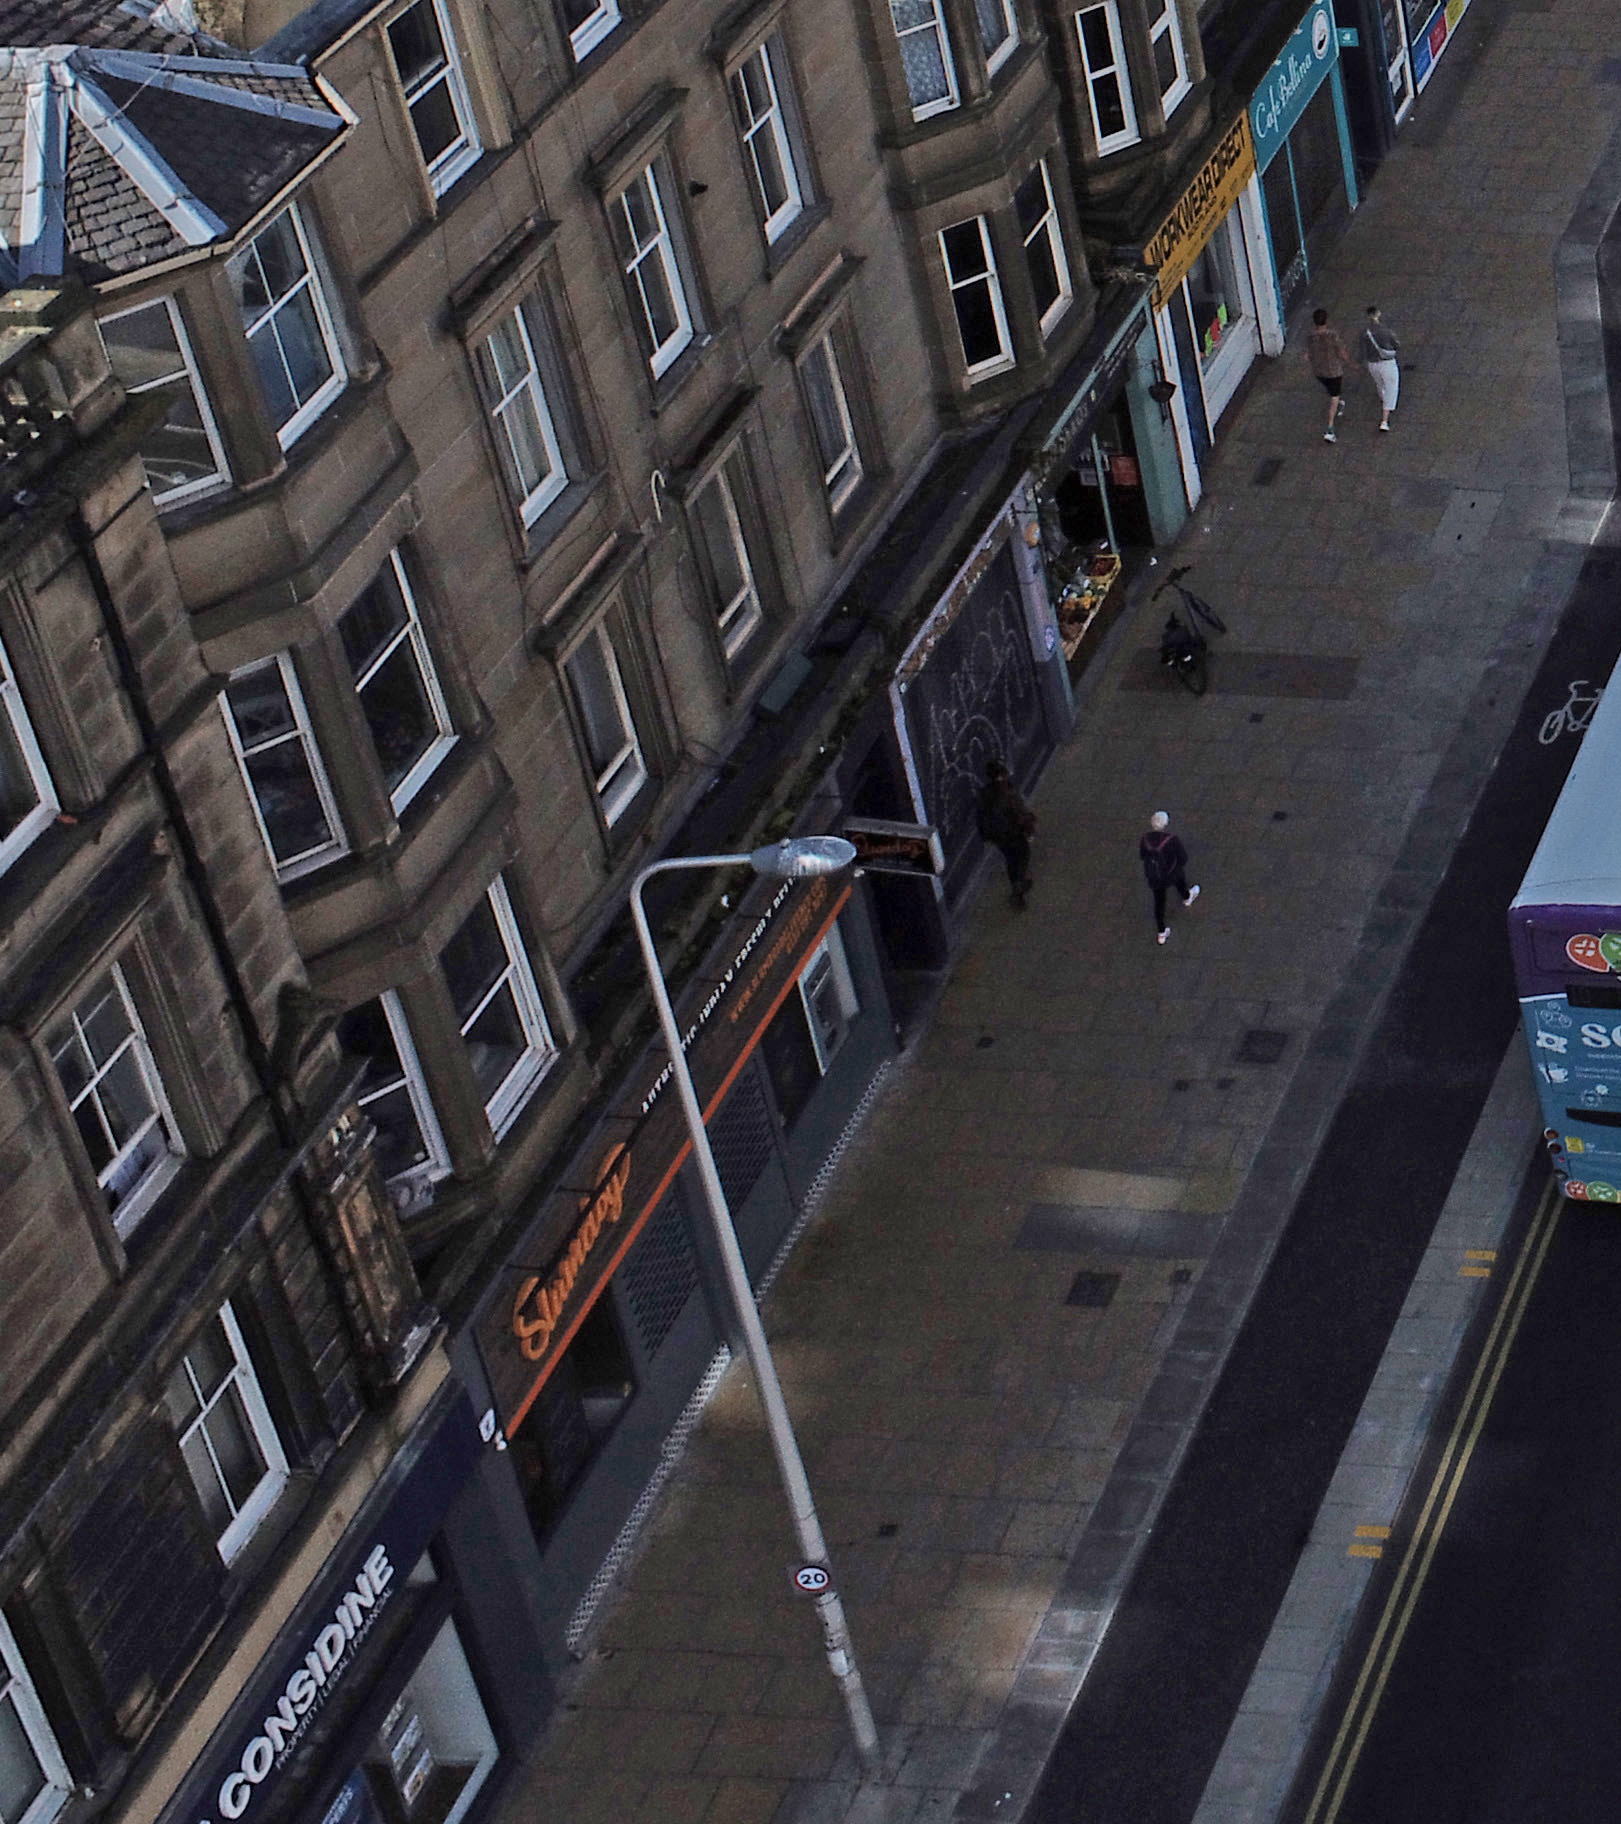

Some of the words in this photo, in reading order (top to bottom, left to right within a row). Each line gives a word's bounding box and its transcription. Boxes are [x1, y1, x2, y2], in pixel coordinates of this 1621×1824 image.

[1278, 52, 1313, 106] Bellina
[1150, 165, 1214, 268] WORKWEAR
[1211, 117, 1245, 189] DIRECT
[513, 1141, 631, 1361] Slumdog
[800, 1573, 826, 1585] 20
[218, 1543, 396, 1821] CONSIDINE
